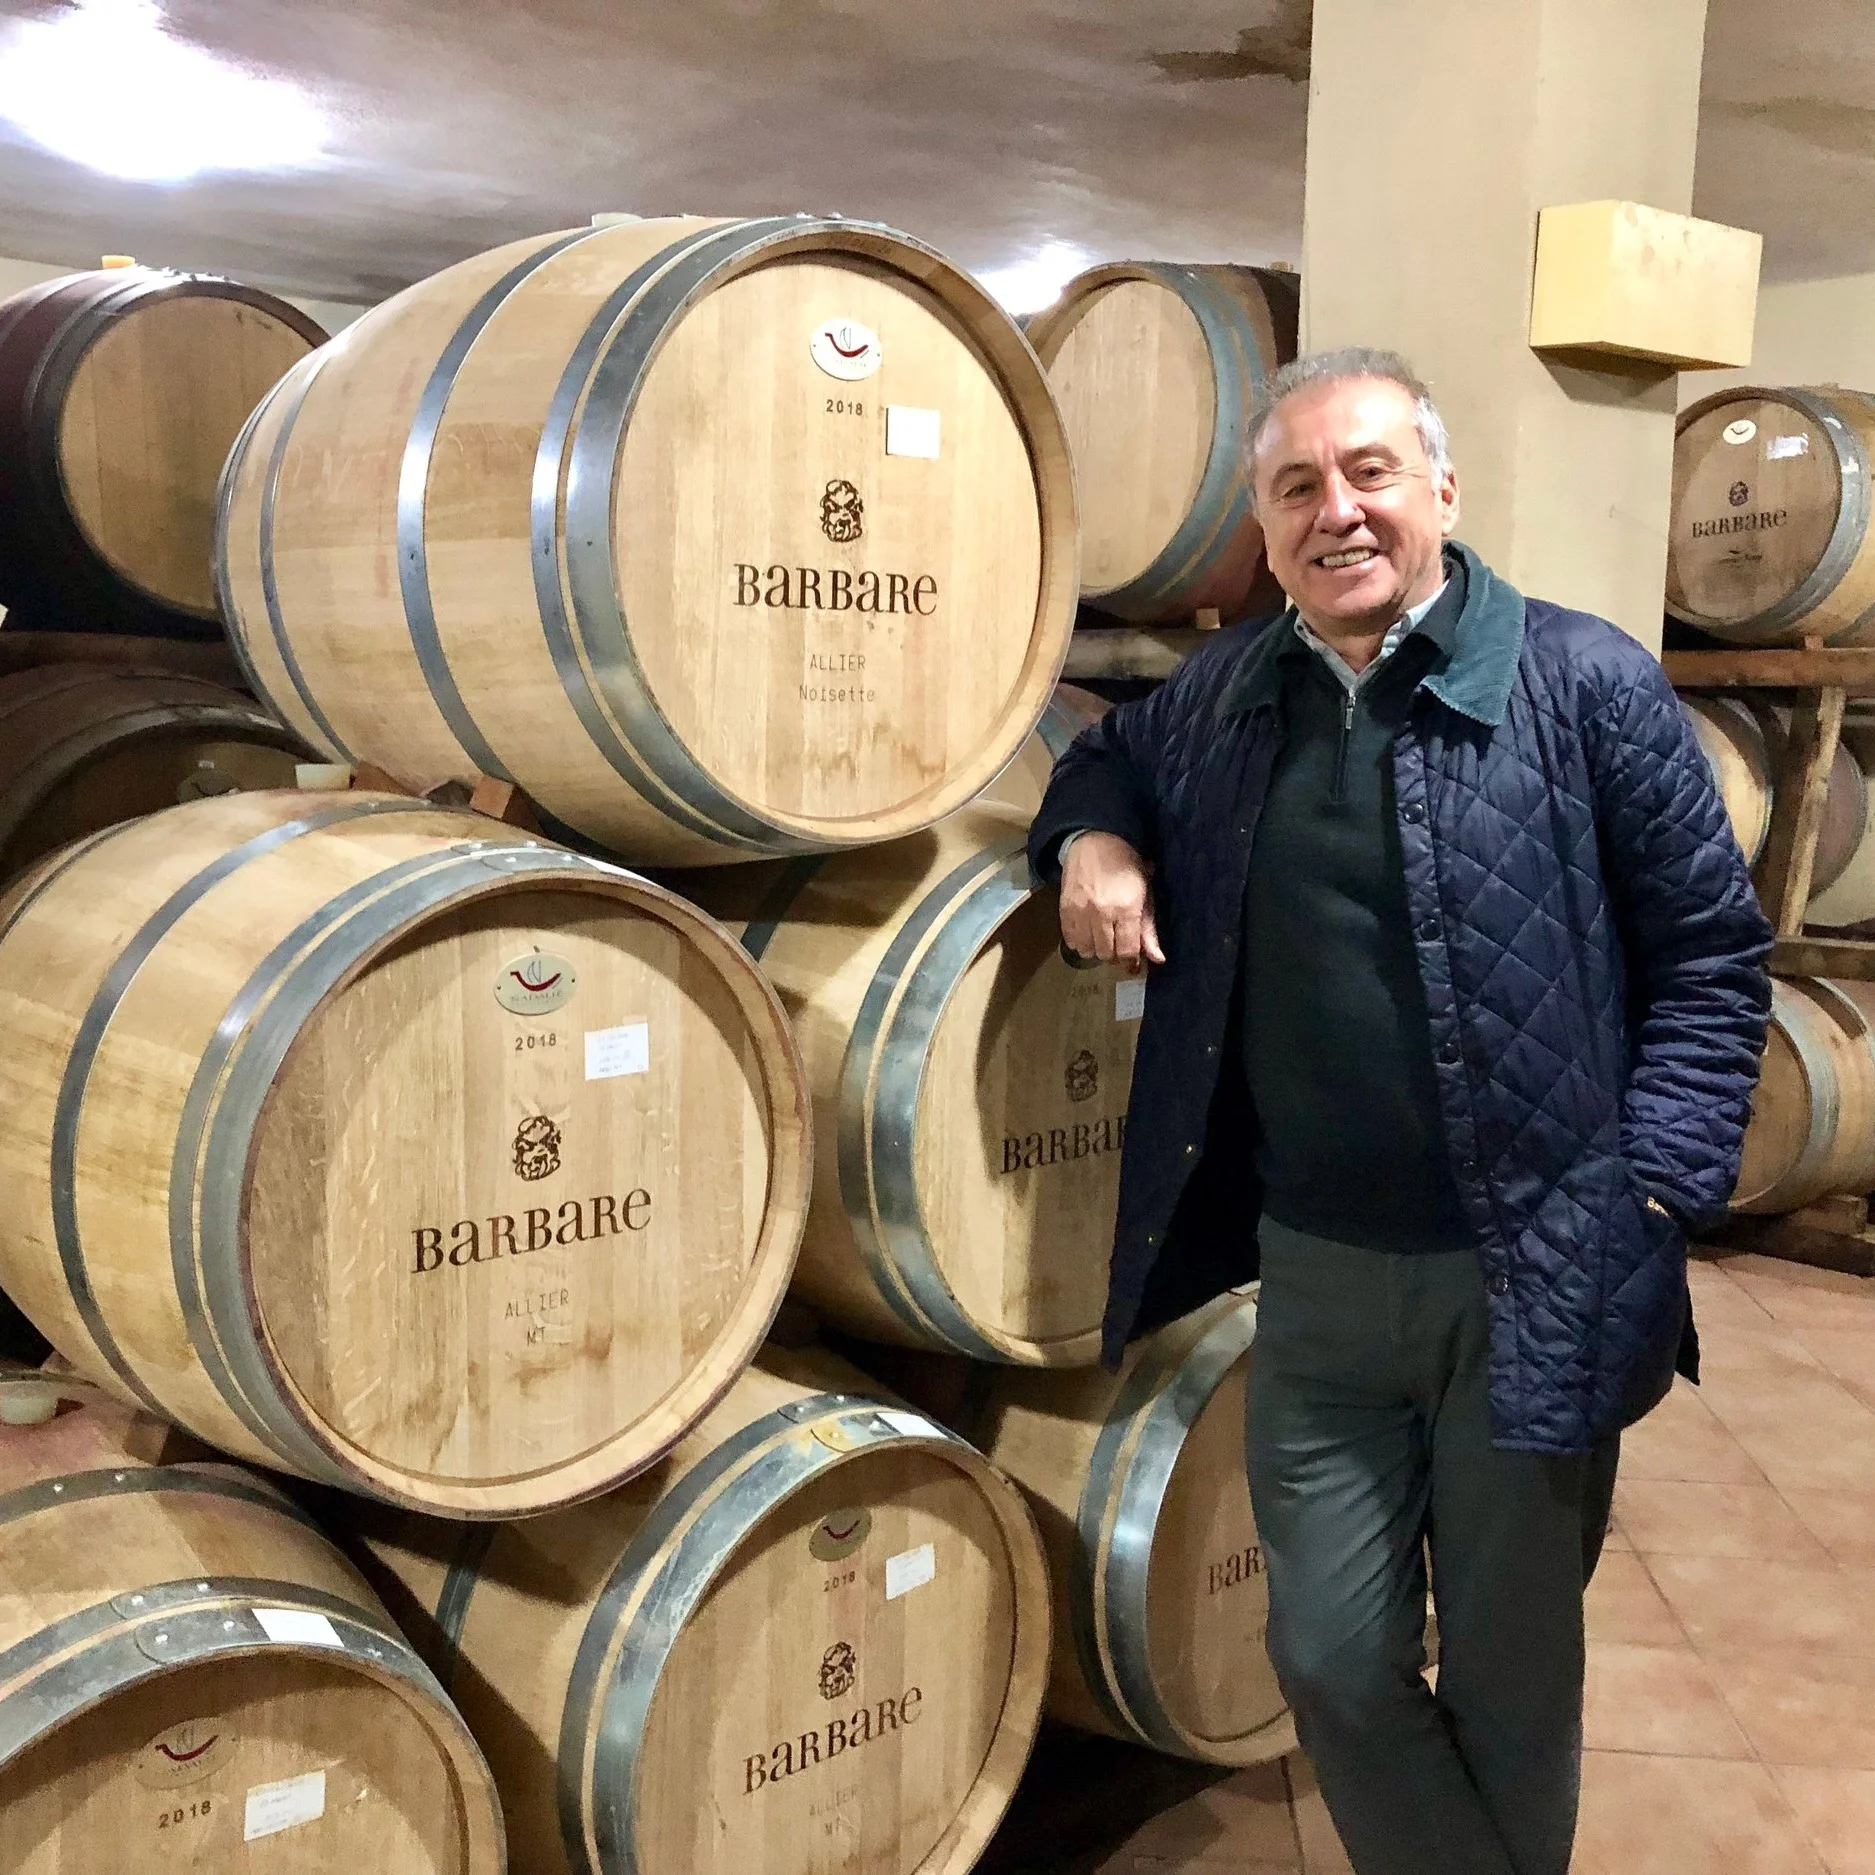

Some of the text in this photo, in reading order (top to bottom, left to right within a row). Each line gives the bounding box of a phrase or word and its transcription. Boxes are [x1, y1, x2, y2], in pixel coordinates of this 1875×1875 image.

[826, 399, 863, 416] 2018
[809, 653, 866, 672] ALLIER
[799, 684, 875, 702] Noisette
[515, 1033, 557, 1051] 2018
[504, 1287, 569, 1320] ALLIER
[823, 1570, 856, 1592] 2018
[158, 1799, 212, 1830] 2018
